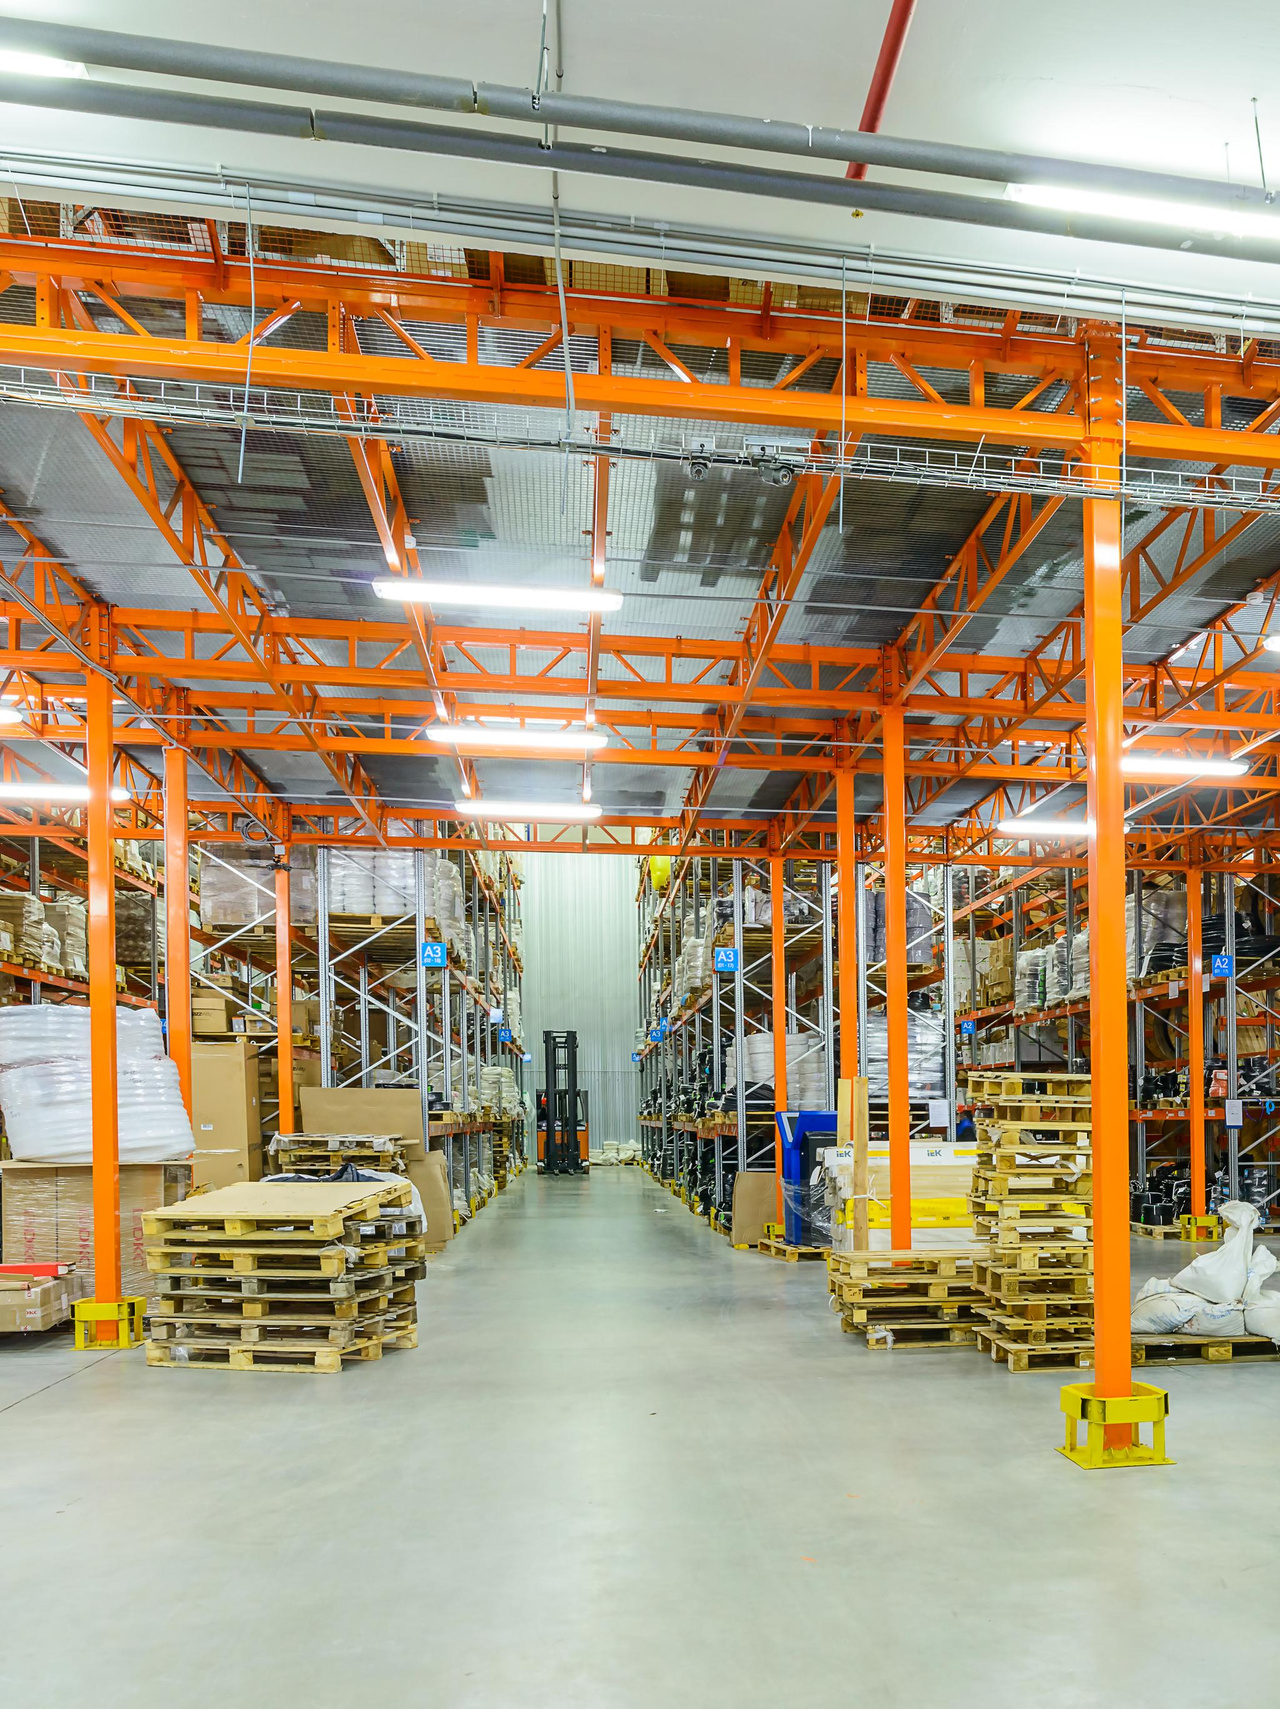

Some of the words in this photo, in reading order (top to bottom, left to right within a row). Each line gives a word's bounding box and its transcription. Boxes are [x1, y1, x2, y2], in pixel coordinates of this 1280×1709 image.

[424, 945, 442, 958] A3
[718, 950, 735, 962] A3
[1214, 957, 1229, 969] A2
[651, 1030, 661, 1038] A3
